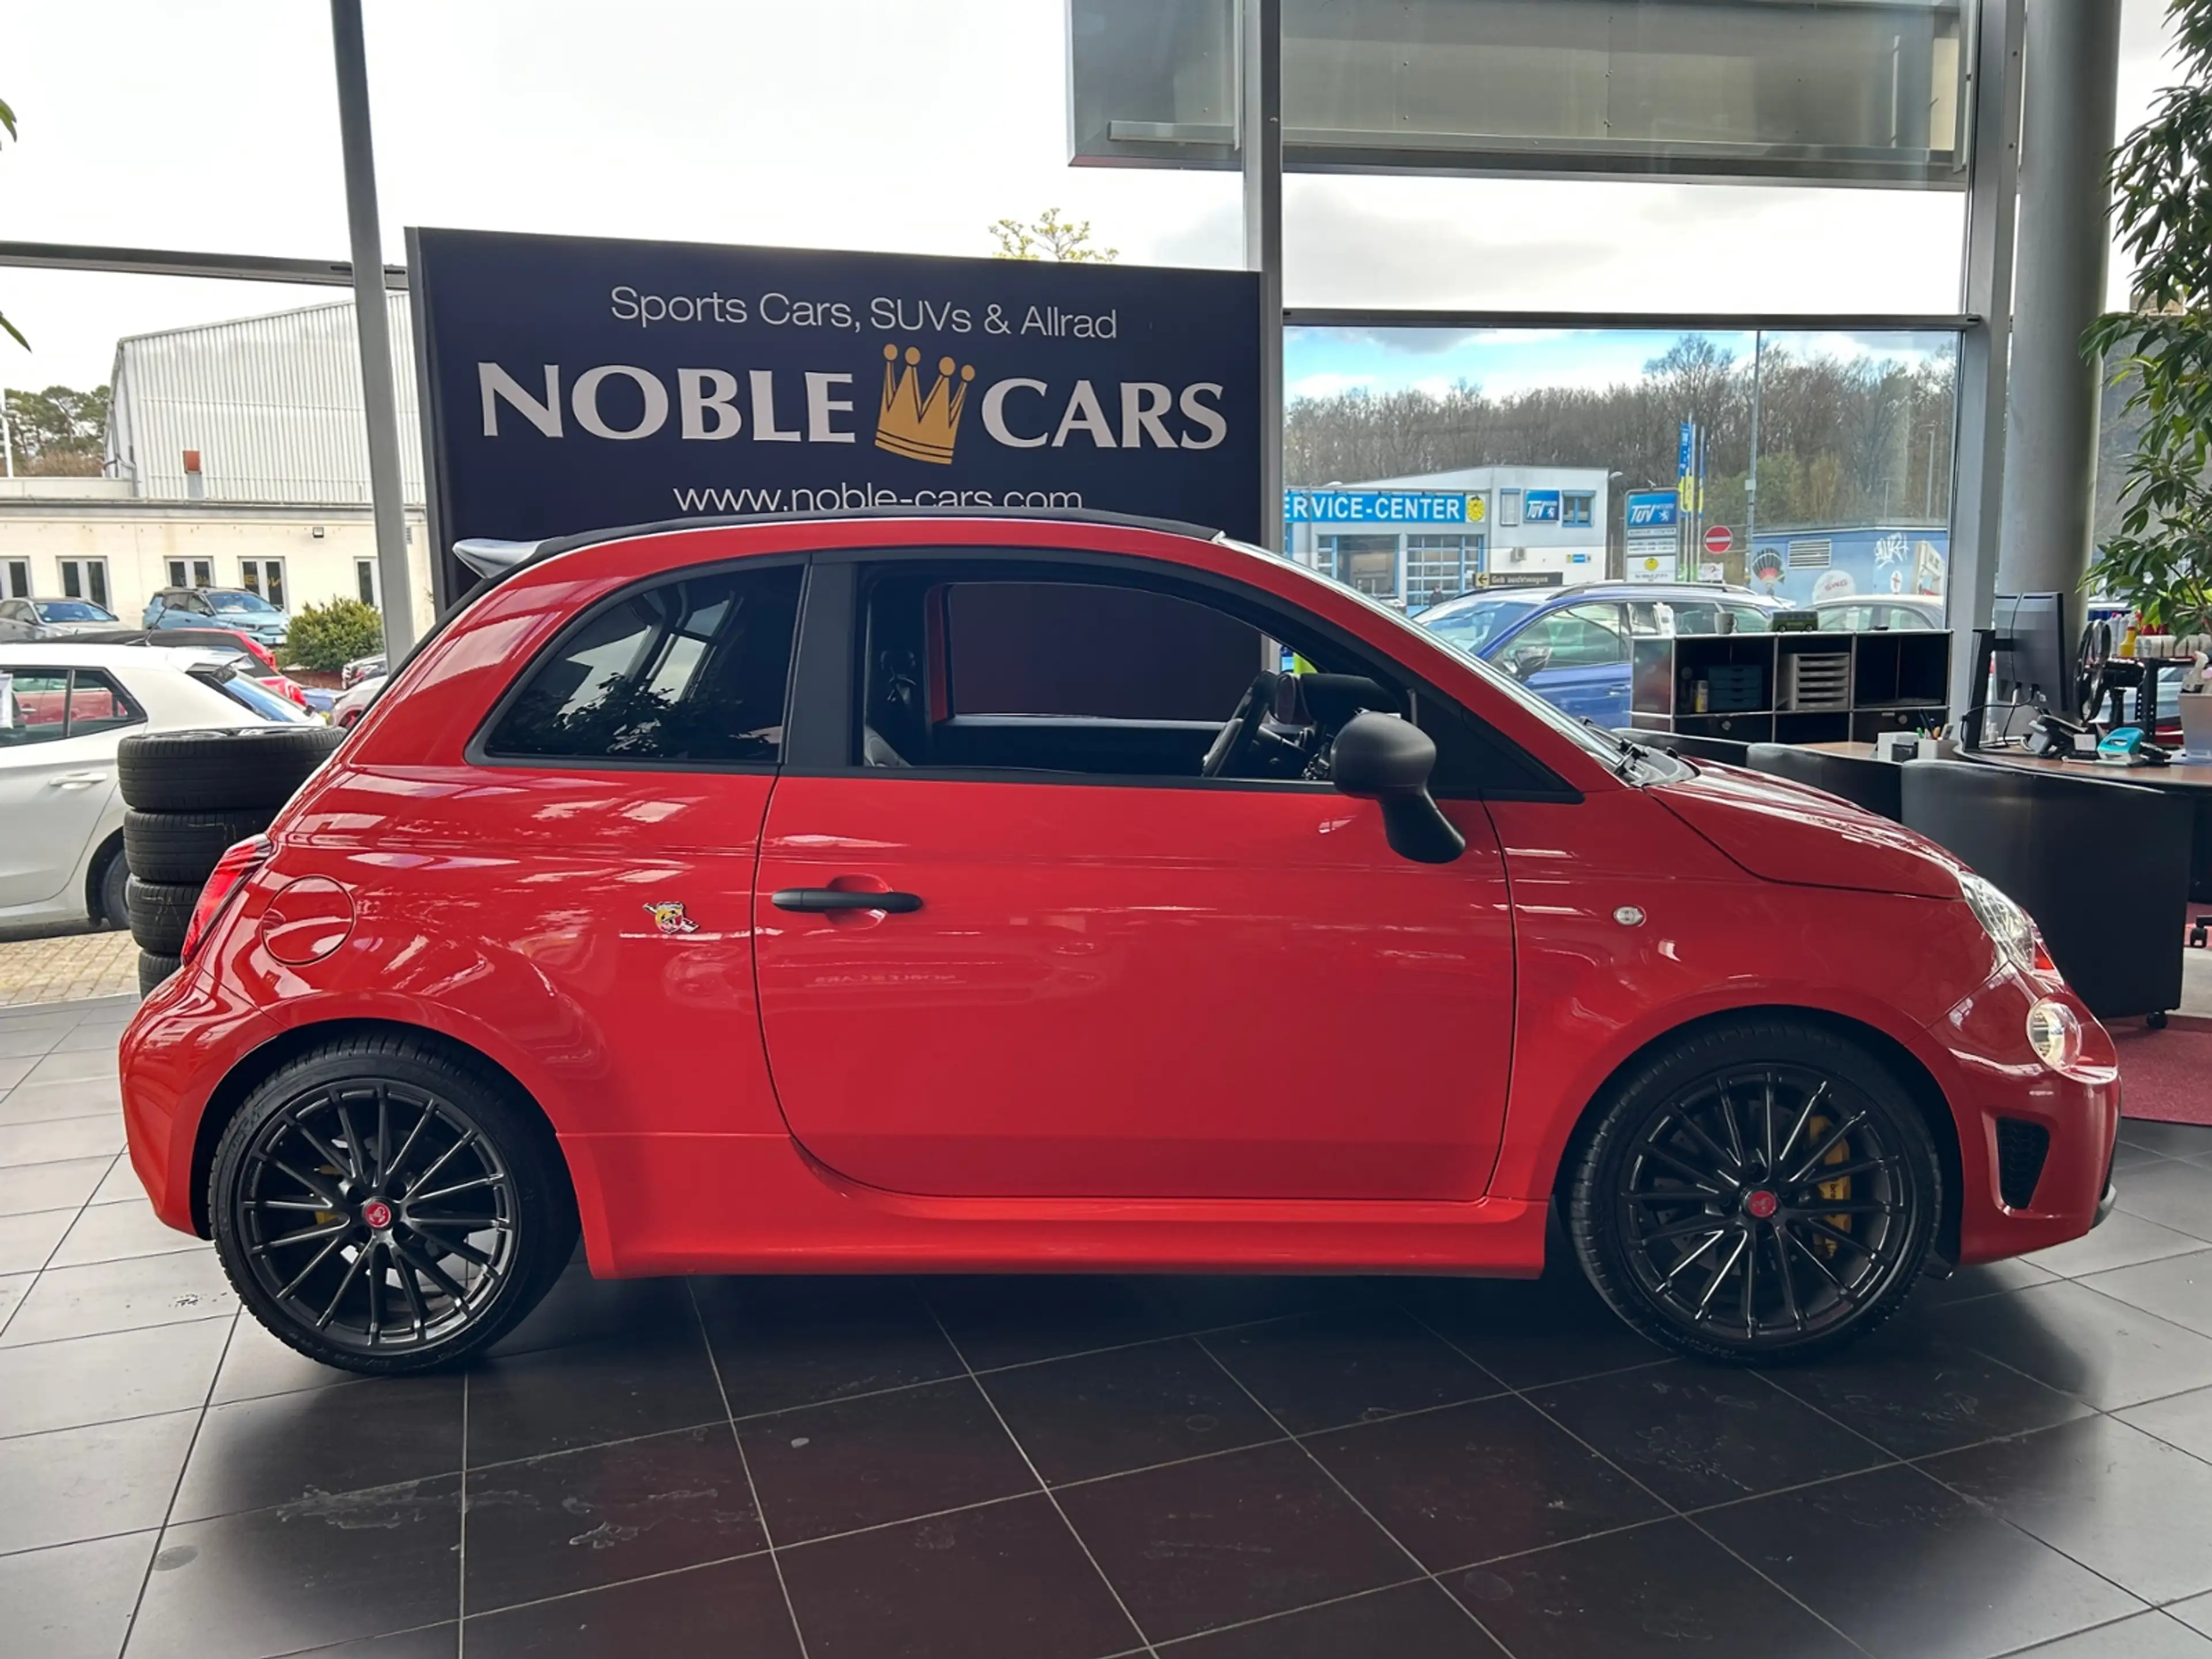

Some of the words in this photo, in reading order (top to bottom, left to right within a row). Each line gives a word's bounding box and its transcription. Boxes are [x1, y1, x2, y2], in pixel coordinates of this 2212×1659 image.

[611, 286, 748, 328] Sports
[760, 293, 861, 333] Cars,
[870, 297, 972, 332] SUVs
[984, 304, 1011, 334] &
[1021, 305, 1117, 339] Allrad
[478, 362, 856, 443] NOBLE
[982, 377, 1228, 449] CARS
[673, 482, 1082, 511] www.noble-carscom
[1284, 496, 1460, 519] ERVICE-CENTER
